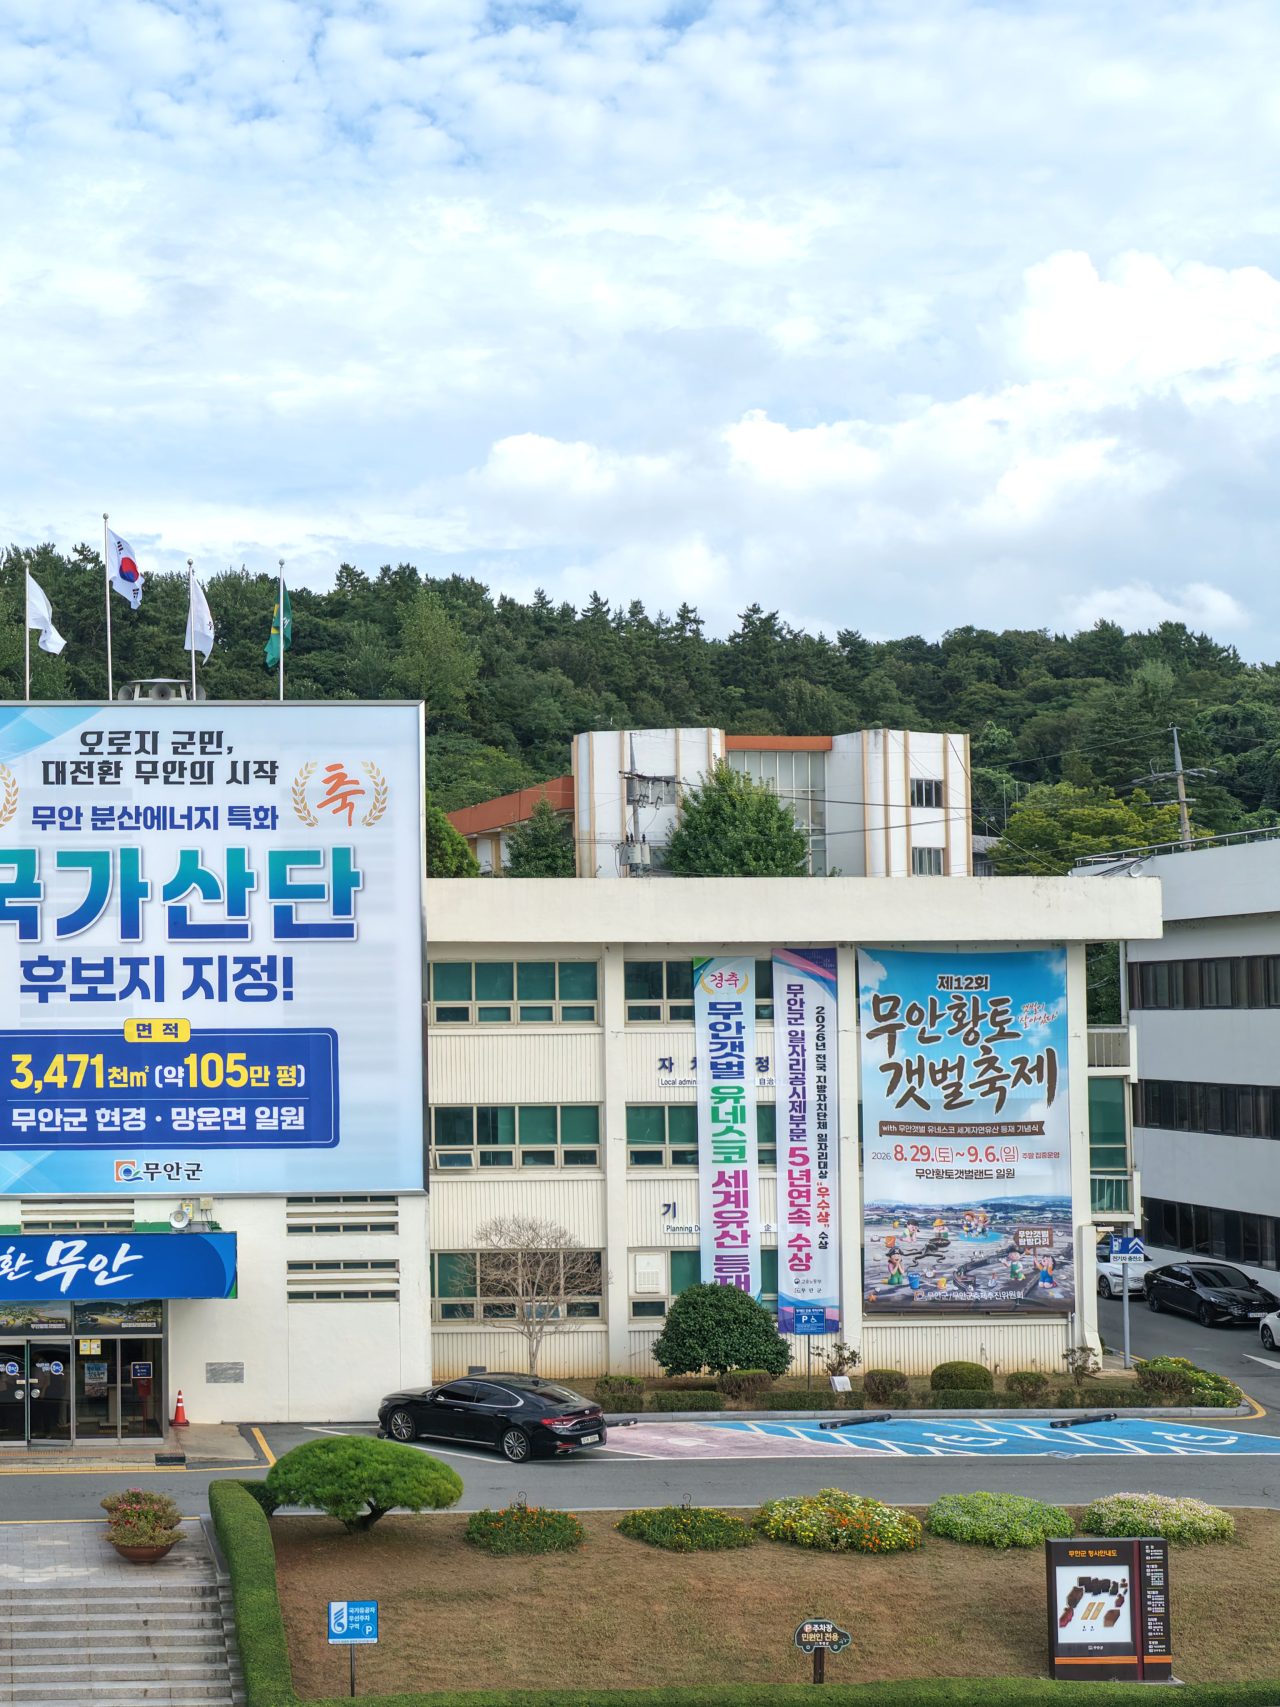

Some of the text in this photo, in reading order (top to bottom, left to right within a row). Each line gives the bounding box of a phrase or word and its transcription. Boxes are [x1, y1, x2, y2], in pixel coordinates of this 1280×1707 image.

[79, 730, 234, 756] 오로지 군민,
[42, 761, 278, 786] 대전환 무안의 시작
[316, 763, 365, 827] 축
[31, 806, 279, 831] 무안 분산에너지 특화
[20, 955, 294, 1003] 후보지 지정!
[937, 975, 989, 990] 제12회
[816, 1006, 826, 1051] 2026년
[866, 993, 1022, 1059] 무안황토
[707, 1001, 746, 1079] 무안갯벌
[660, 1078, 697, 1086] Local admin
[879, 1045, 1058, 1114] 갯벌축제
[816, 1075, 828, 1130] 지방자치단체
[11, 1107, 305, 1132] 무안군 현경 망운면 일원
[710, 1086, 748, 1163] 유네스코
[786, 984, 813, 1272] 무안군 일자리공시제부문 5년연속 수상
[898, 1125, 926, 1133] 무안갯벌
[927, 1125, 956, 1134] 유네스코
[957, 1126, 1000, 1134] 세계자연유산
[1001, 1125, 1015, 1133] 등재
[1017, 1124, 1039, 1133] 기념식
[817, 1133, 829, 1180] 일자리대상
[142, 1162, 203, 1182] 무안군
[915, 1168, 1016, 1179] 무안황토갯벌랜드 일원
[711, 1169, 751, 1249] 세계유산
[666, 1225, 693, 1233] Planning
[34, 1239, 144, 1293] 무안
[802, 1315, 808, 1323] P
[365, 1625, 372, 1634] P
[801, 1632, 839, 1641] 민원인 전용
[812, 1624, 832, 1632] 주차장
